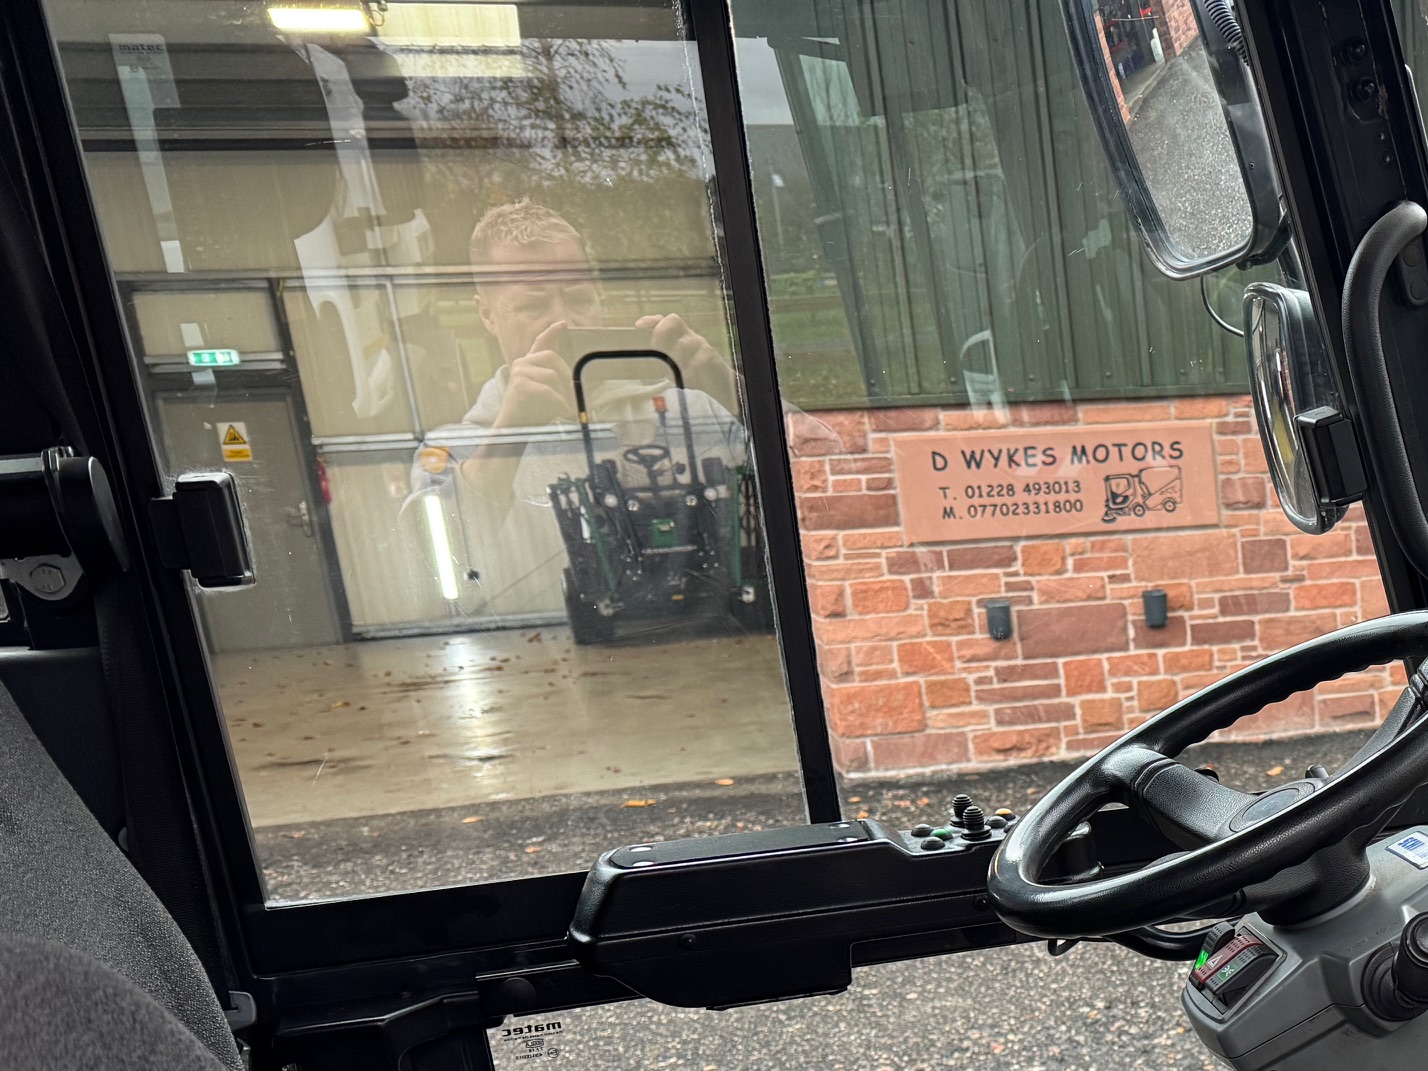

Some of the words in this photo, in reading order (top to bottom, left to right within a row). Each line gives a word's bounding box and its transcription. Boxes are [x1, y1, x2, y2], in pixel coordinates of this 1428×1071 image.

[931, 450, 949, 473] D
[960, 446, 1057, 471] WYKES
[1071, 440, 1184, 465] MOTORS
[964, 483, 1016, 499] 01228
[1023, 480, 1082, 497] 493013
[967, 499, 1084, 518] 07702331800
